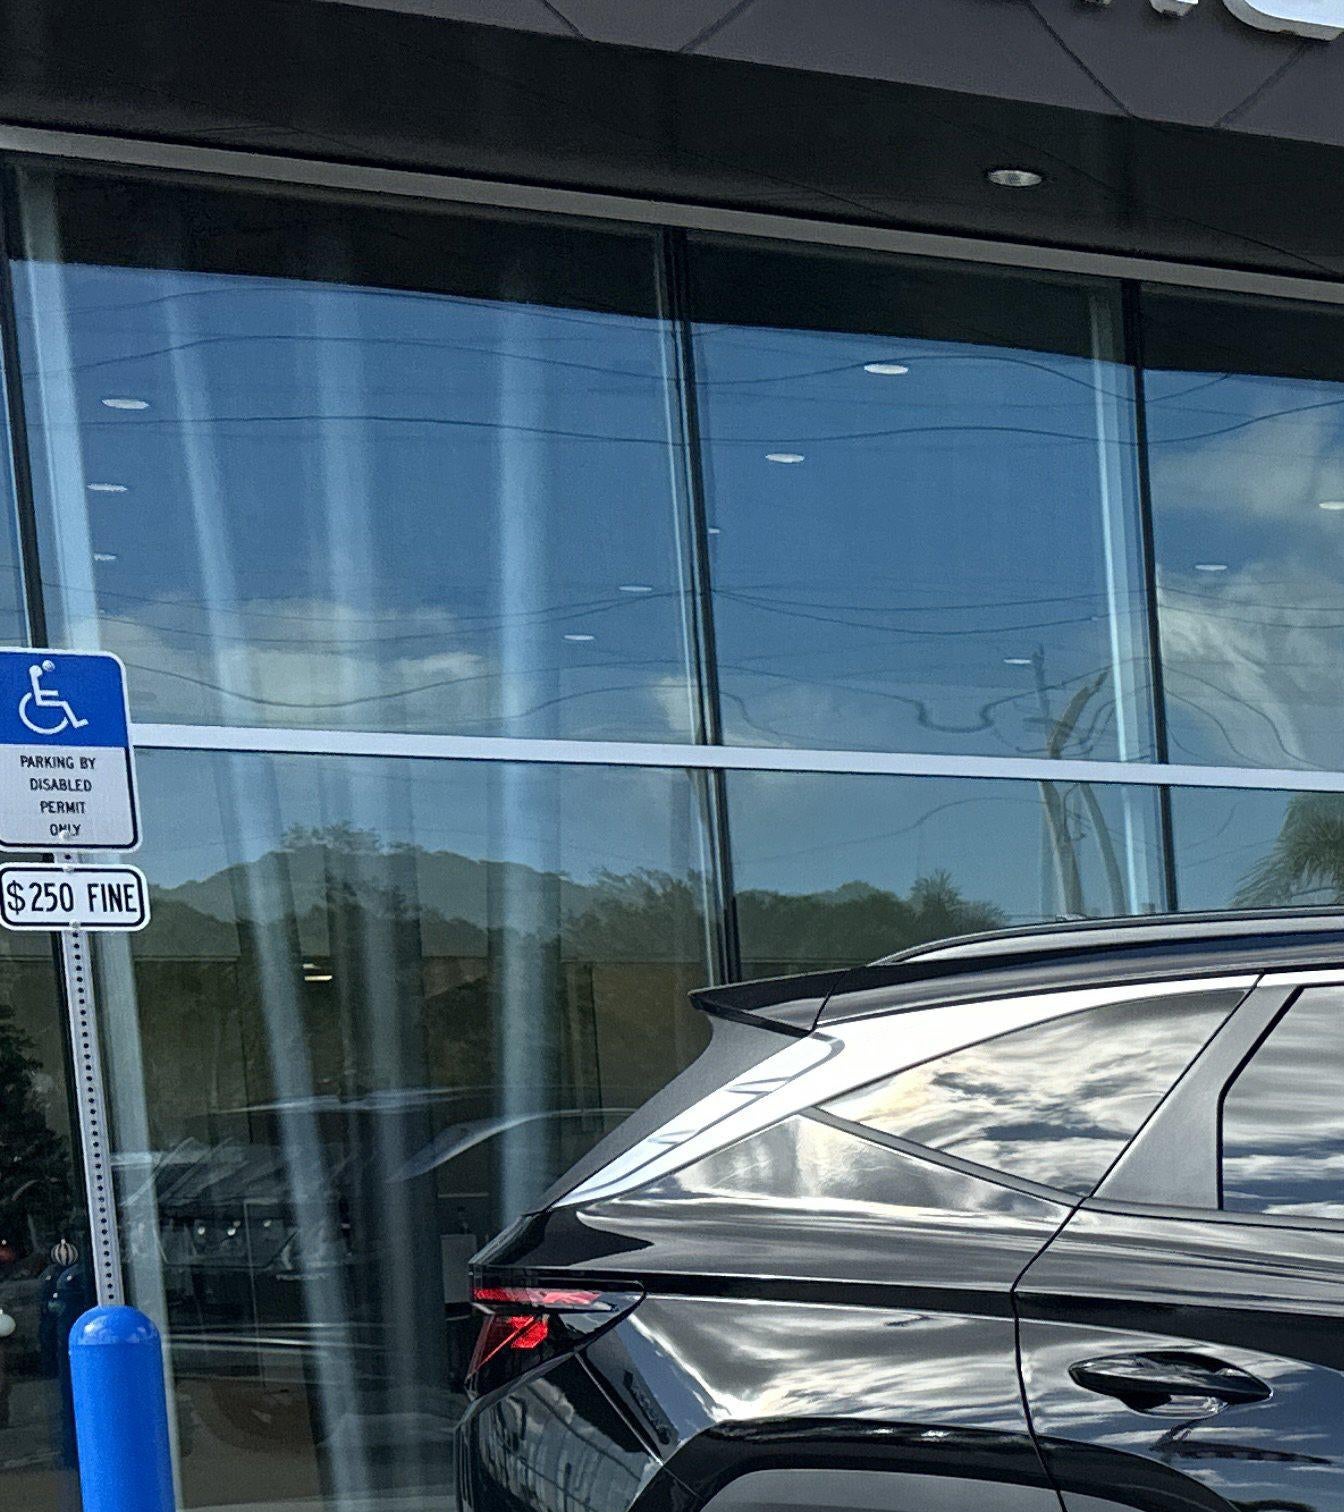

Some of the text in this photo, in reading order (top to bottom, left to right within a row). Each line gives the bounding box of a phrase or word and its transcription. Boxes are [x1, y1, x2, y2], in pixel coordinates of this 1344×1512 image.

[20, 755, 96, 769] PARKING BY
[29, 778, 92, 792] DISABLED
[40, 801, 86, 814] PERMIT
[7, 880, 138, 915] $250 FINE
